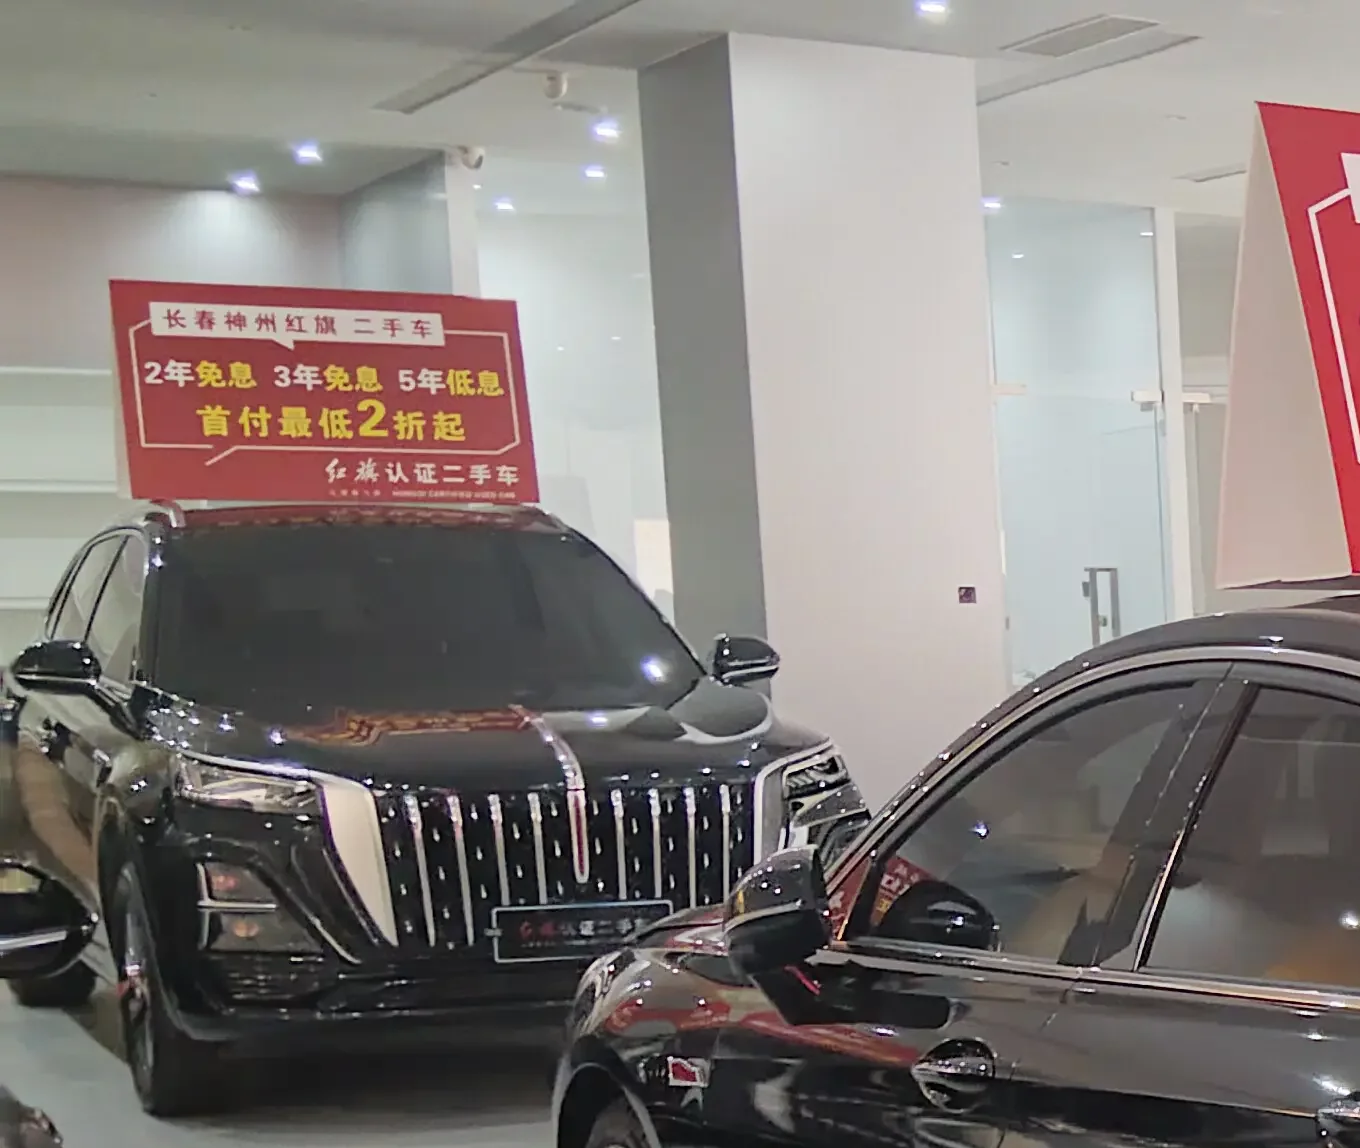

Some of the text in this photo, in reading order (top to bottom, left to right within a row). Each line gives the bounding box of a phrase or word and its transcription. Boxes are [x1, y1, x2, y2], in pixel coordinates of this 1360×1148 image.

[163, 309, 434, 338] 长春神州红旗 二手车
[144, 360, 504, 397] 2年免息 3年免息 5年低息
[196, 399, 467, 442] 首付最低2折起
[325, 457, 519, 486] 红旗认证二手车
